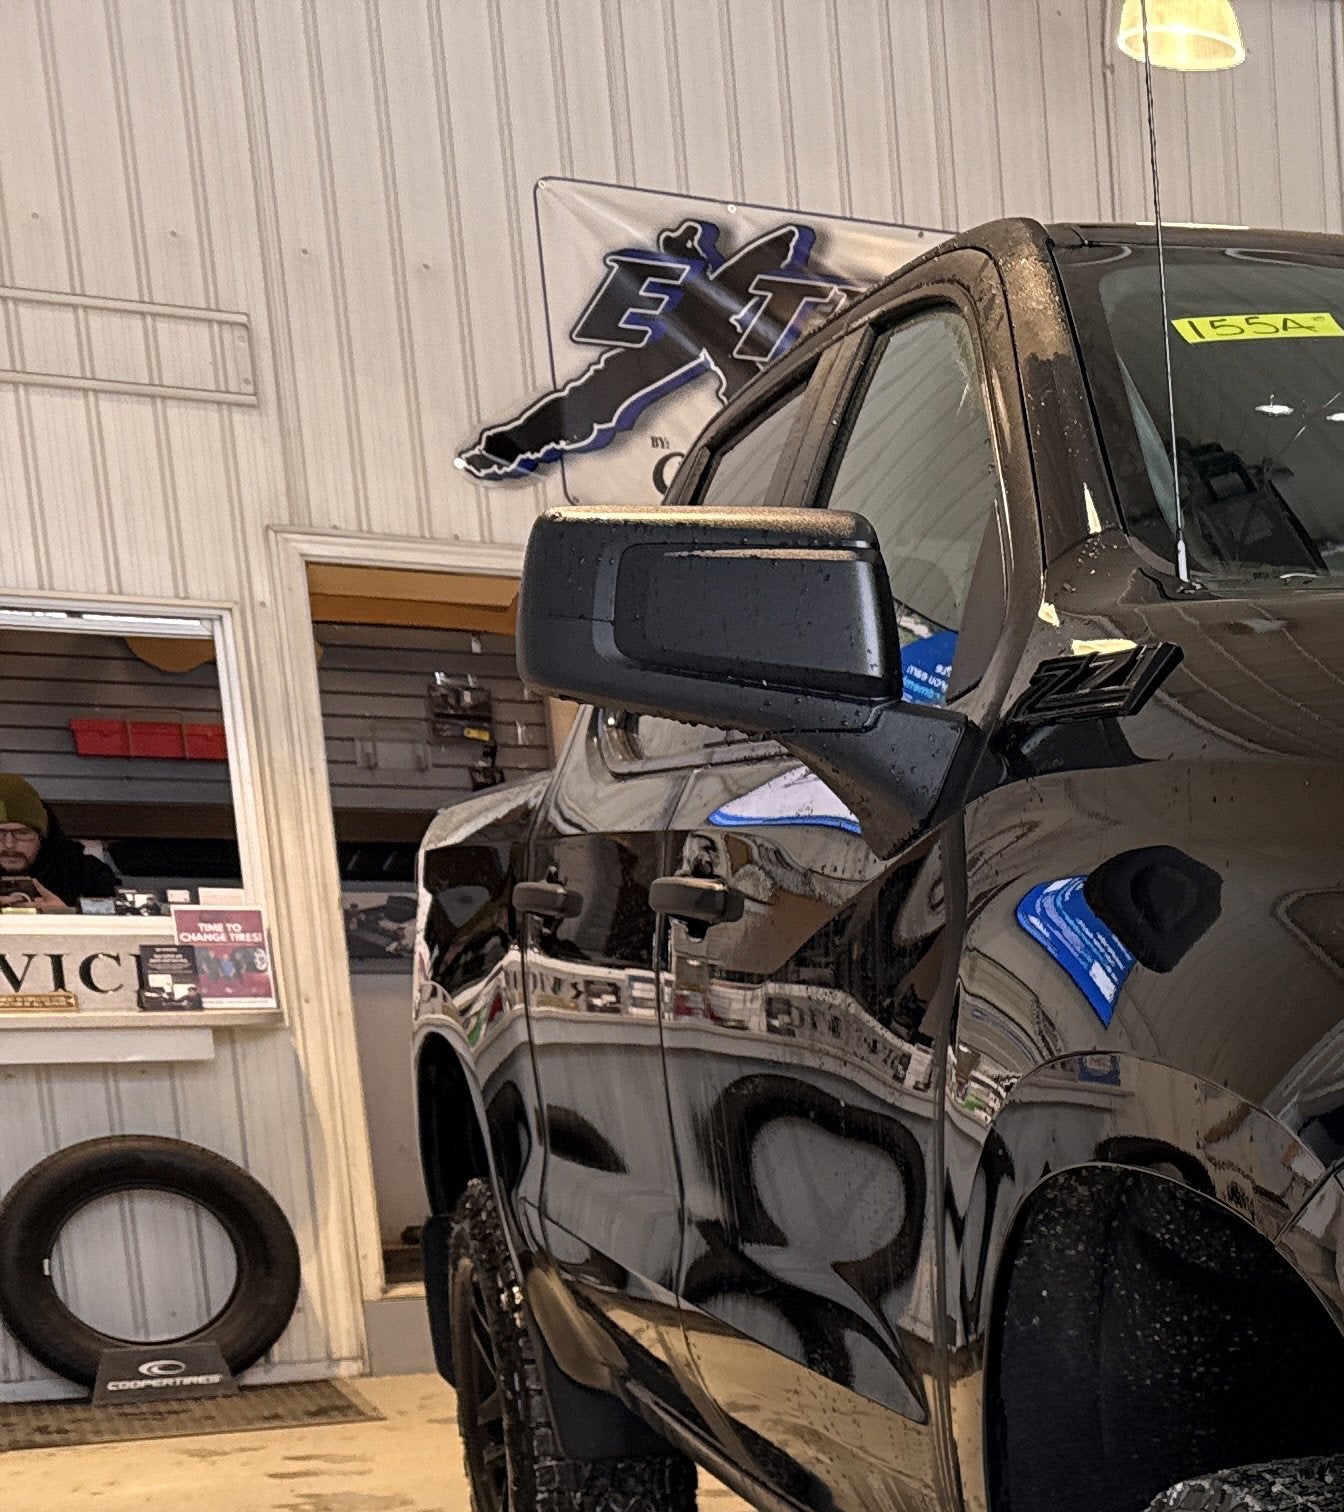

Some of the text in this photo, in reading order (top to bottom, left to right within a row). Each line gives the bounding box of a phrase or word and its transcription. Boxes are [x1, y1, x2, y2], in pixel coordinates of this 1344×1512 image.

[197, 922, 243, 933] TIME TO
[179, 932, 263, 943] CHANGE TIRES!
[0, 952, 142, 995] VIC
